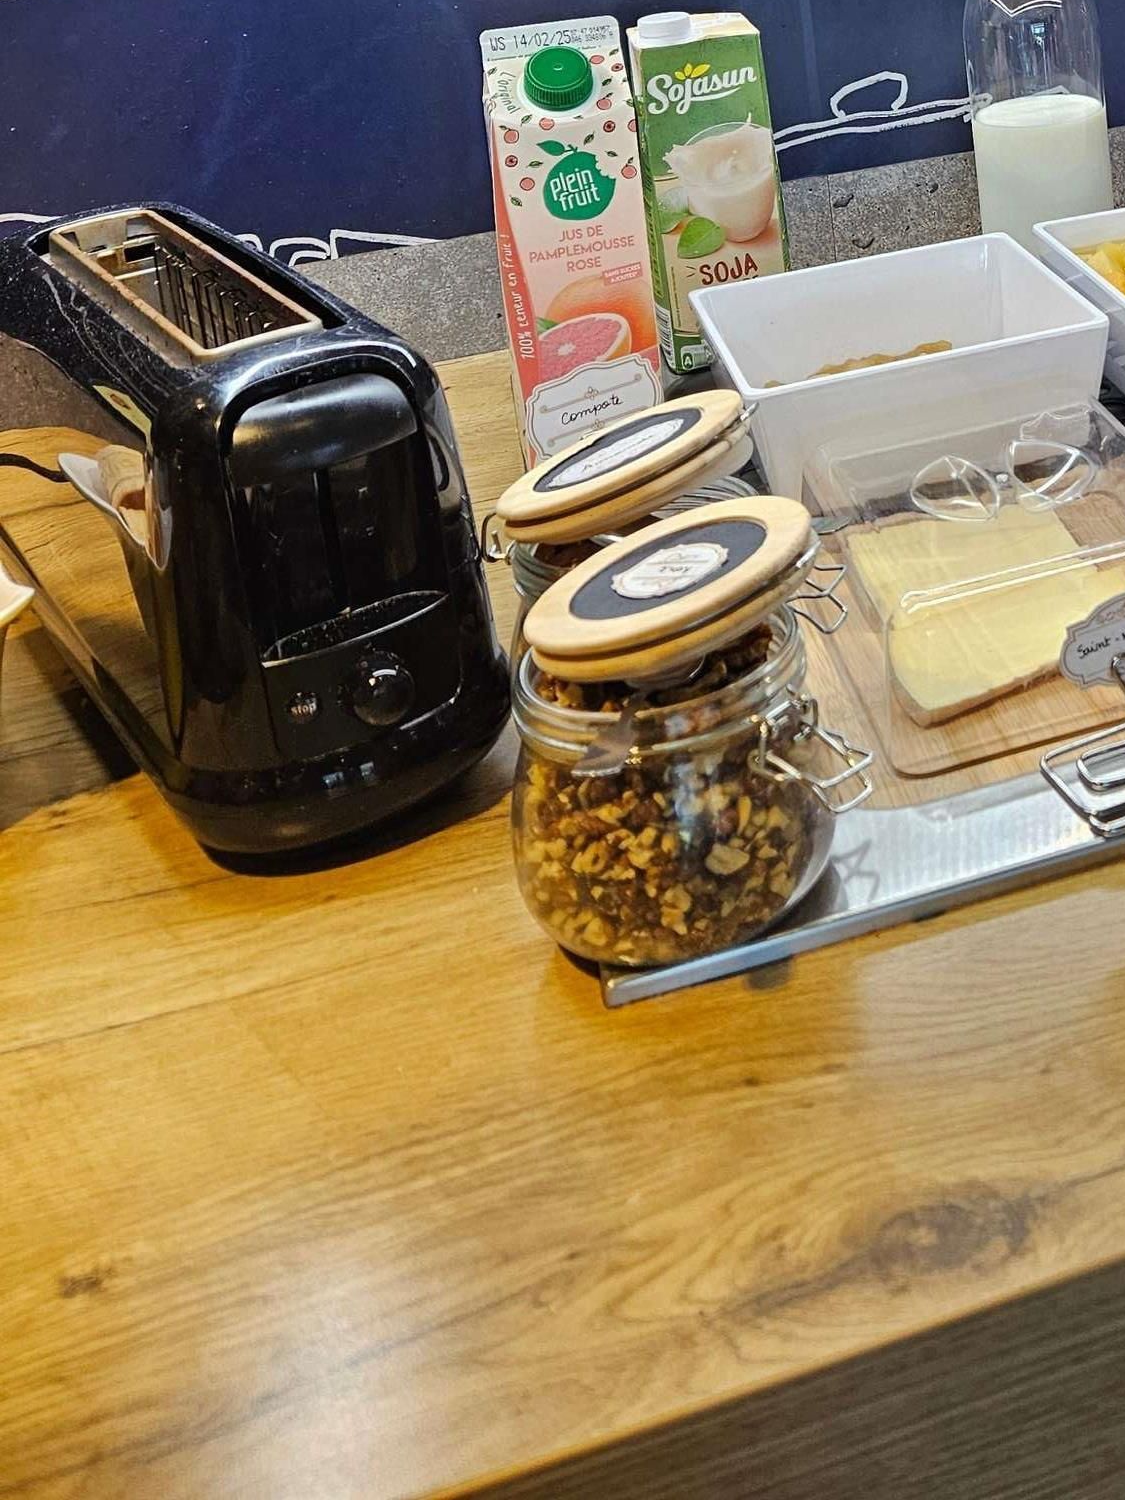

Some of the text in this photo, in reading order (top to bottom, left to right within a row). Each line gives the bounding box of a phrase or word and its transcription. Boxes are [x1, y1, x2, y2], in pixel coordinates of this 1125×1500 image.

[513, 29, 572, 49] 14/02/25
[646, 66, 758, 115] Sojasun
[549, 167, 594, 201] plein
[558, 184, 601, 212] fruit
[558, 224, 604, 243] JUS DE
[503, 241, 515, 270] fruit
[528, 235, 635, 263] PAMPLEMOUSSE
[566, 256, 602, 273] ROSE
[699, 253, 759, 286] SOJA
[508, 271, 520, 288] en
[518, 329, 535, 360] 100%
[561, 393, 624, 426] Compote
